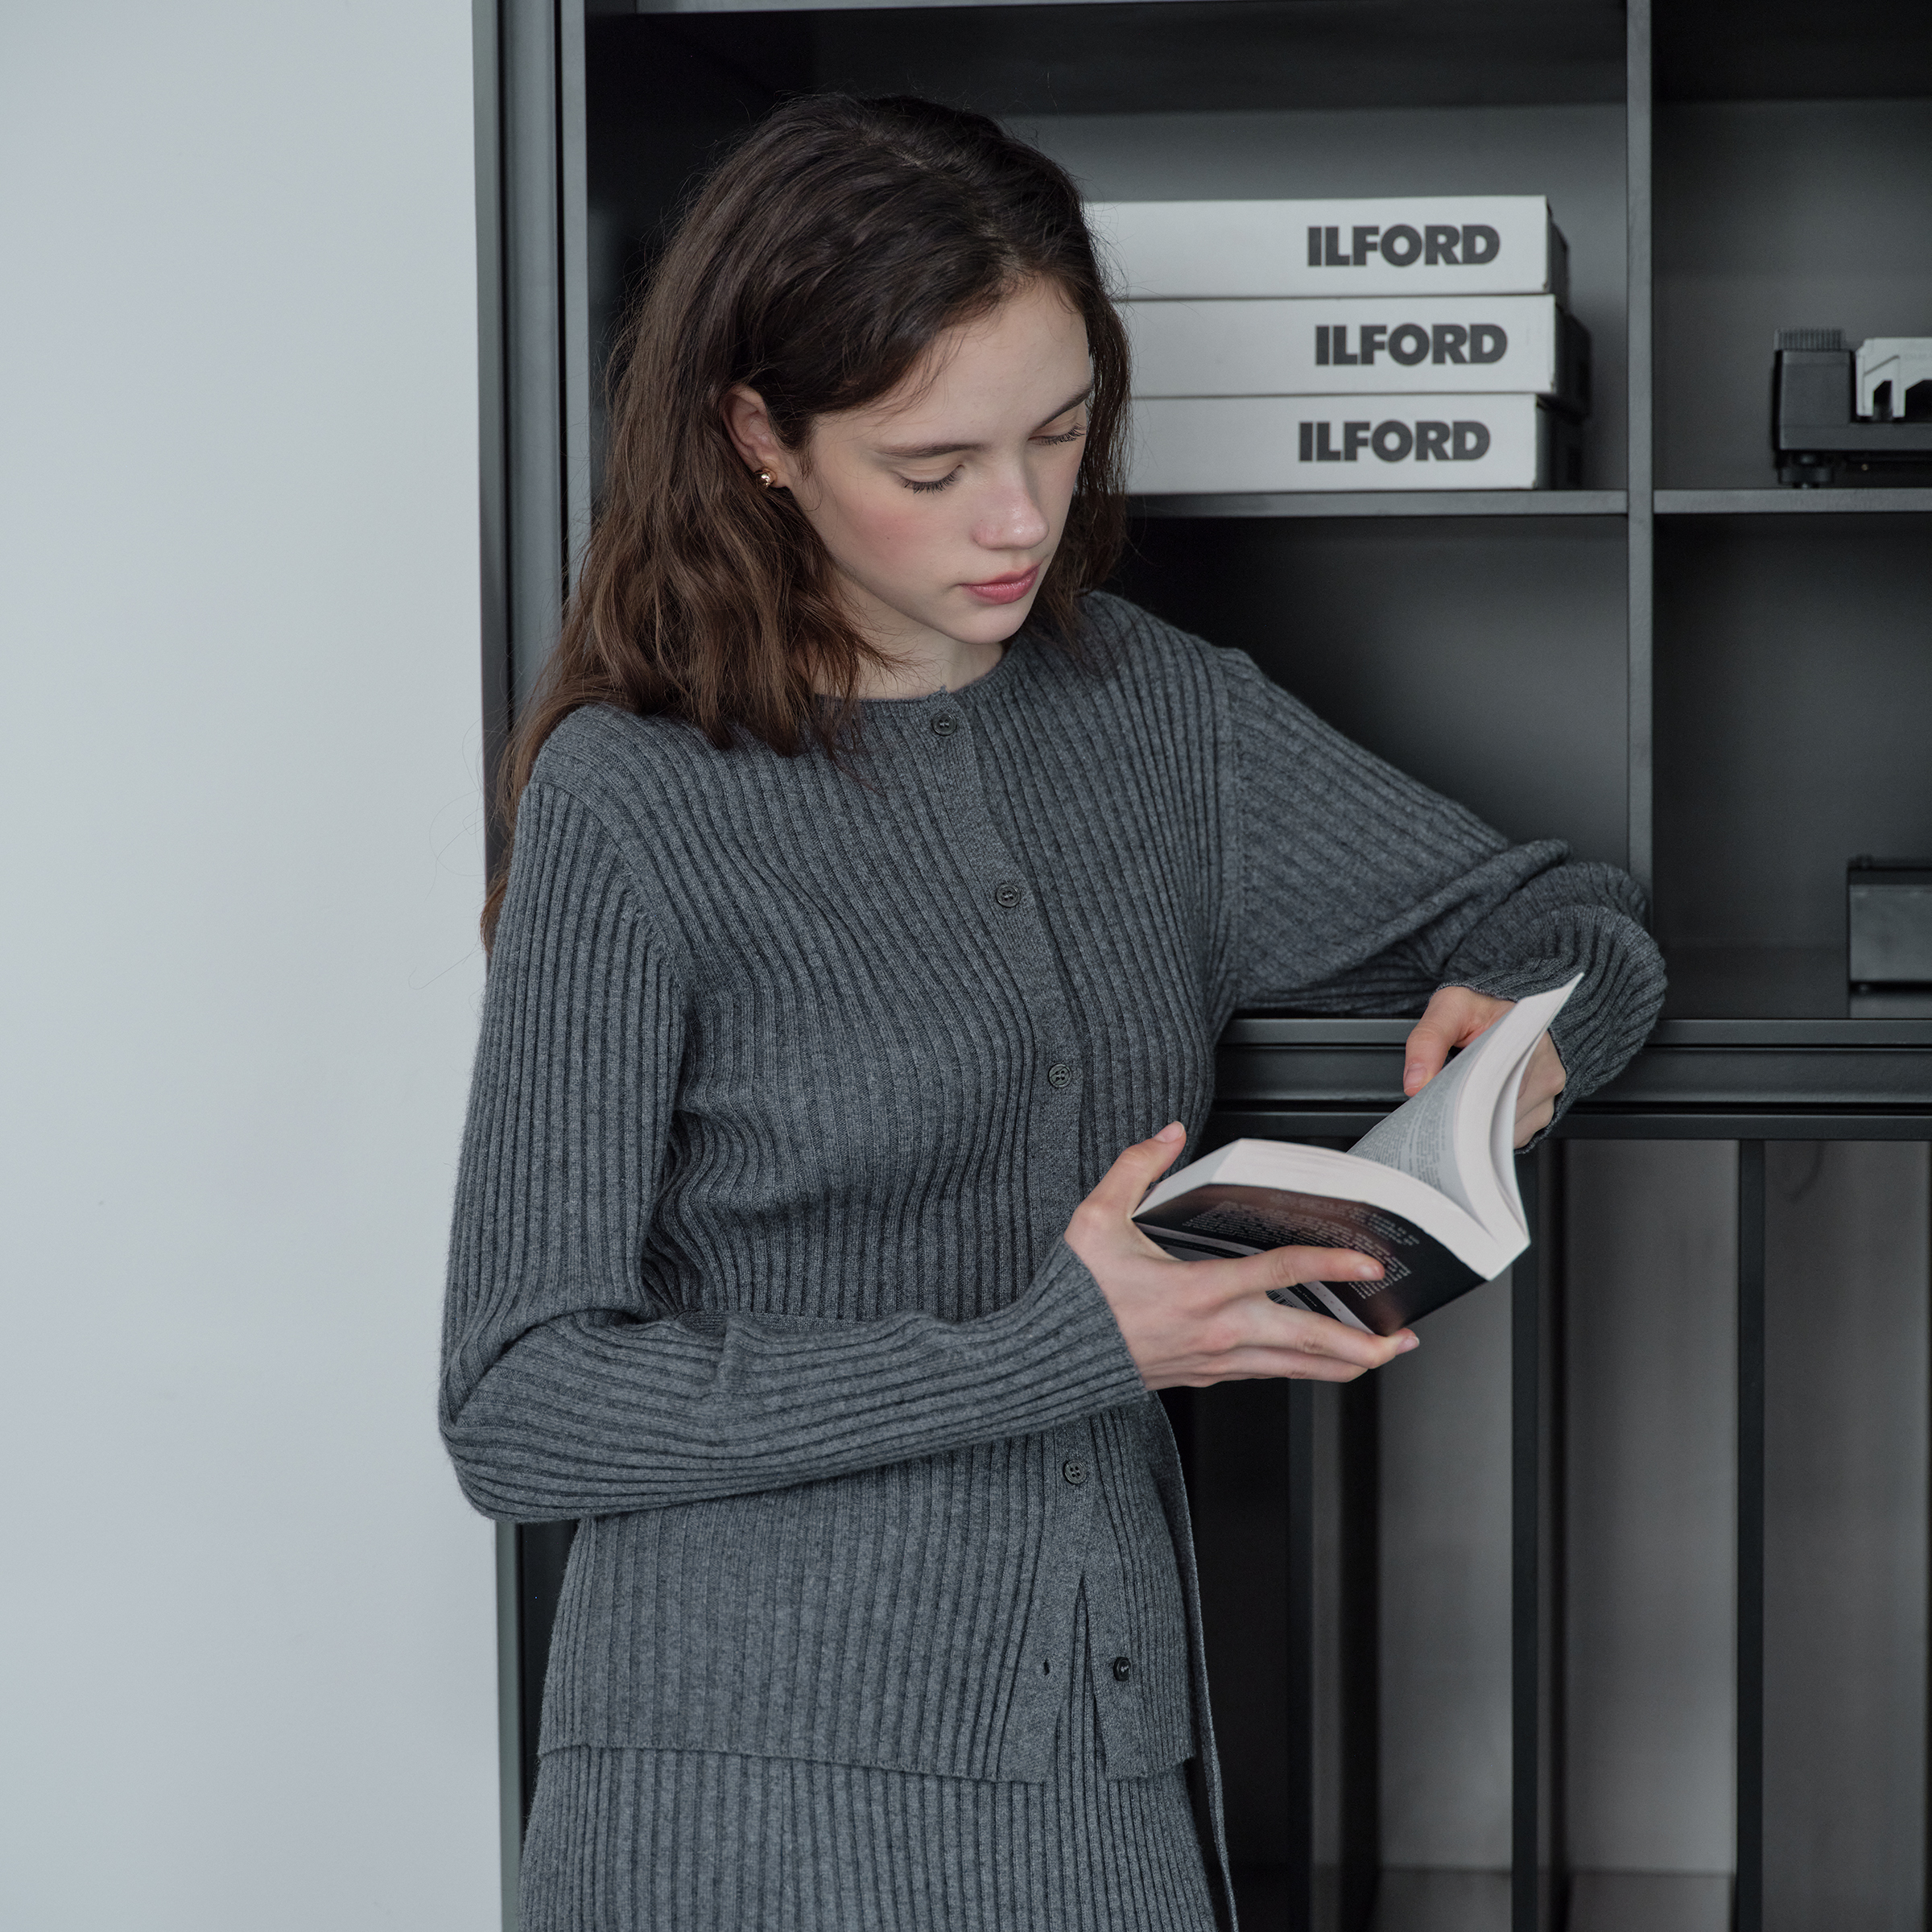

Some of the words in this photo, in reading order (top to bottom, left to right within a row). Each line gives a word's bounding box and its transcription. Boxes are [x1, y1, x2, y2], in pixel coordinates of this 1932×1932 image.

[1308, 225, 1500, 266] ILFORD
[1315, 323, 1507, 366] ILFORD
[1299, 419, 1490, 463] ILFORD
